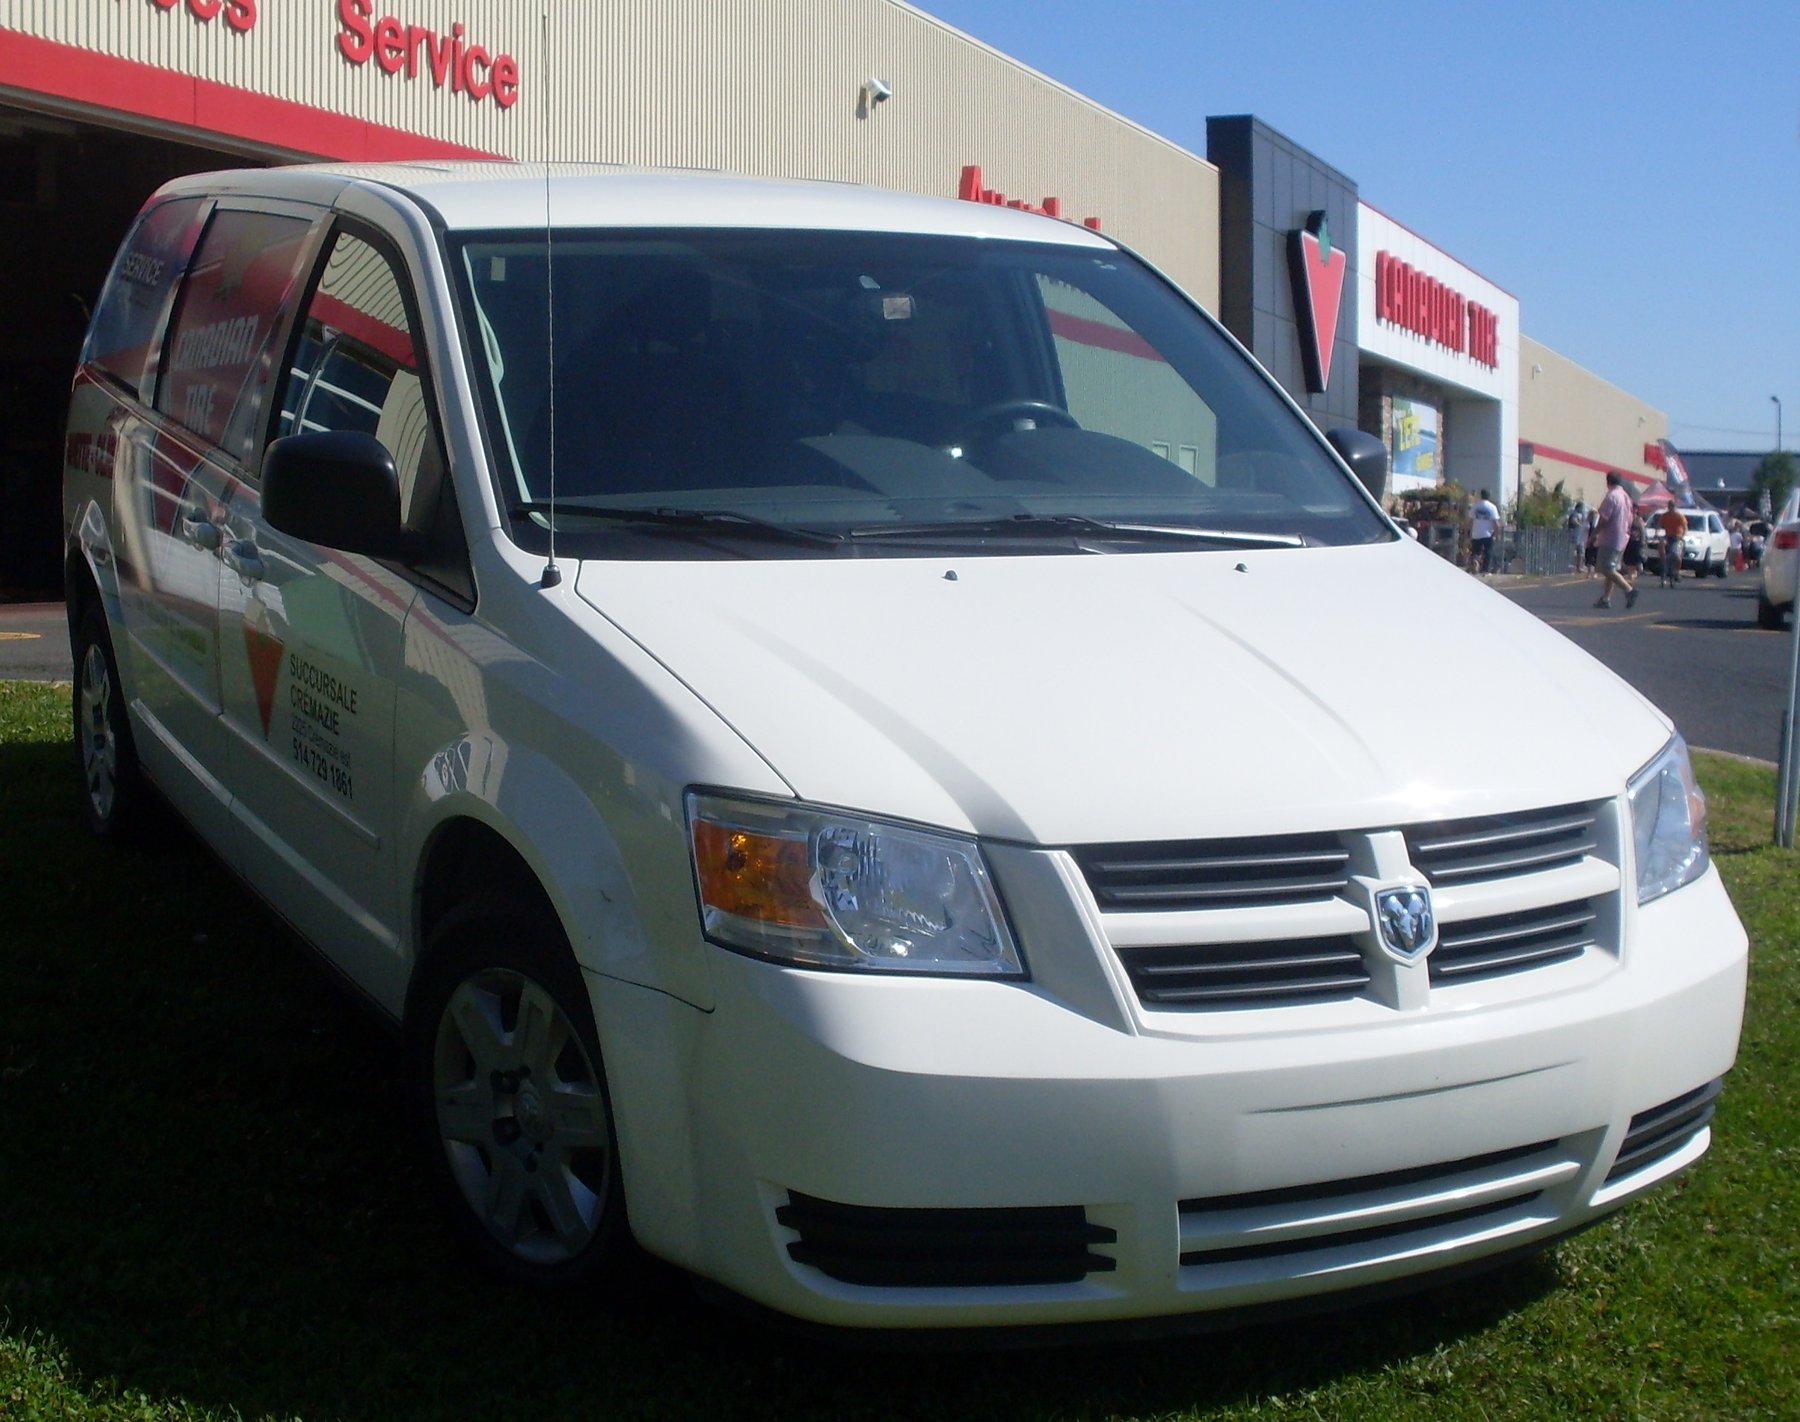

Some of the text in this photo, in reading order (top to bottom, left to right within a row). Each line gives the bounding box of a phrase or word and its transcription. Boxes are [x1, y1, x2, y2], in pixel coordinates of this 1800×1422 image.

[338, 0, 518, 106] Service
[1376, 250, 1467, 353] CANADIAN
[290, 653, 357, 714] SUCCURSALE
[293, 737, 353, 800] 514 729 1861
